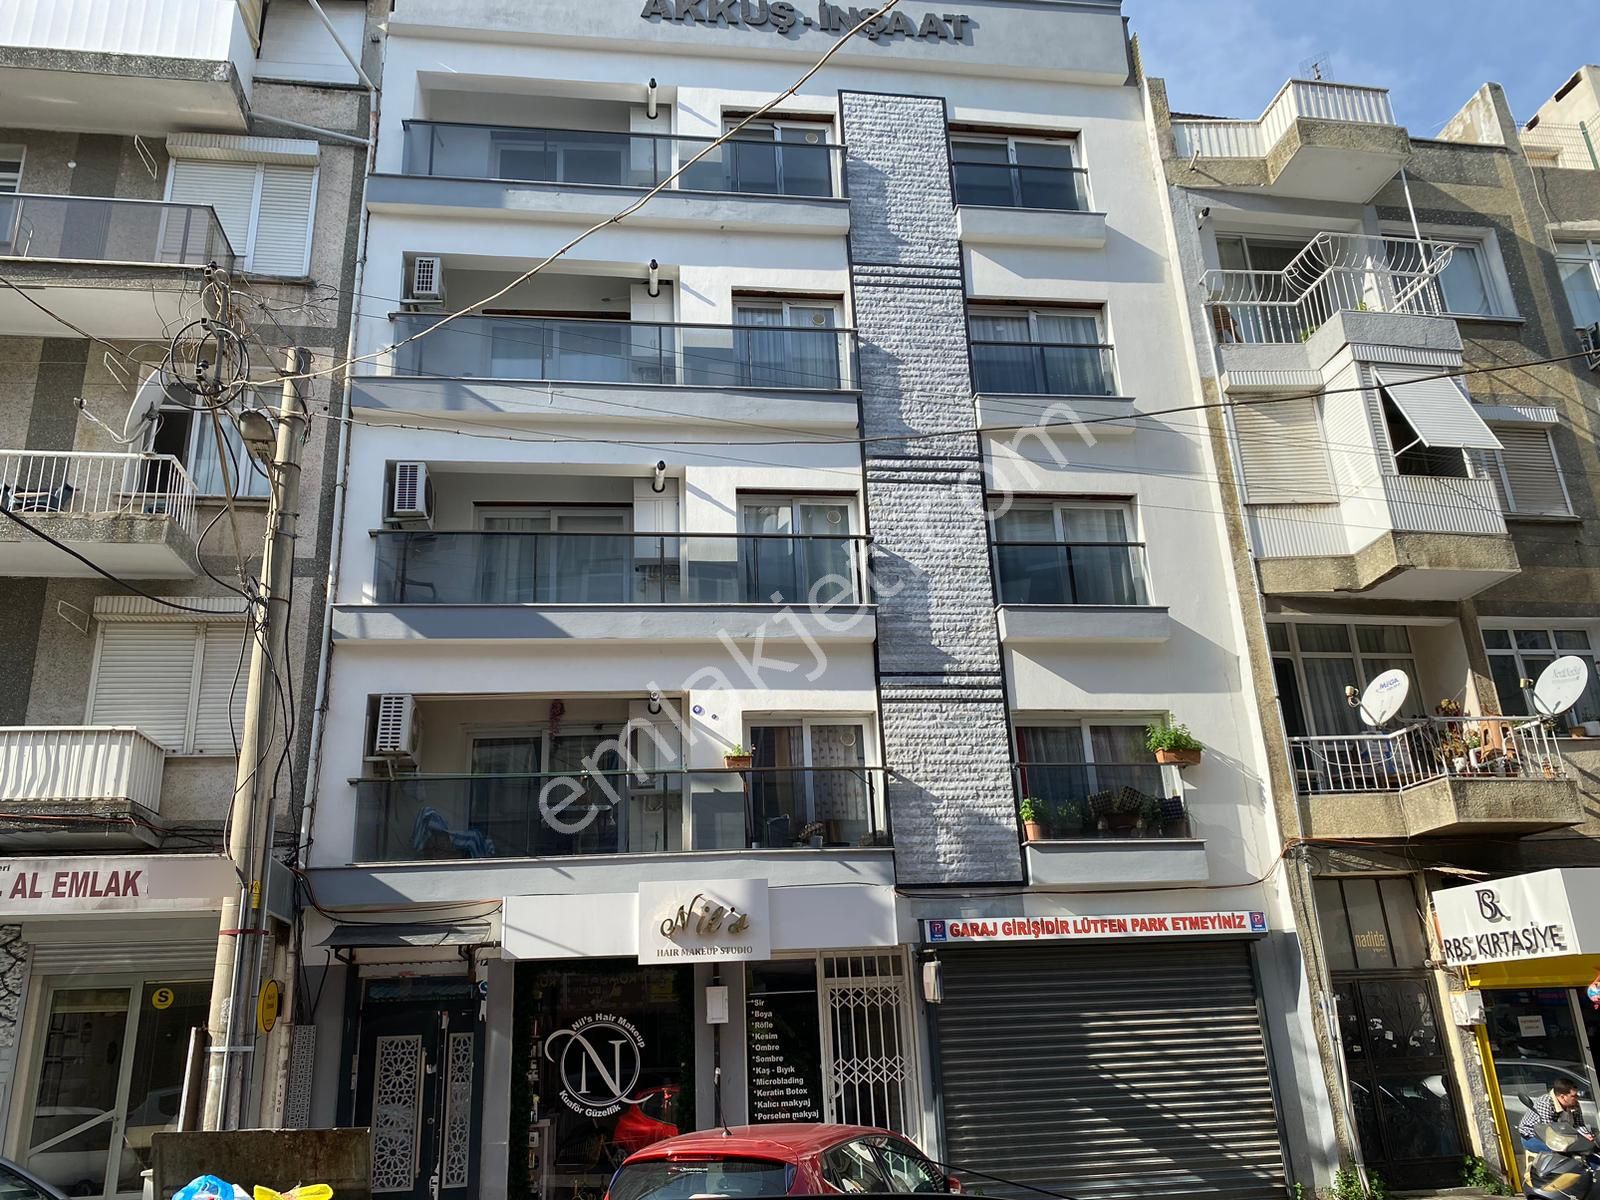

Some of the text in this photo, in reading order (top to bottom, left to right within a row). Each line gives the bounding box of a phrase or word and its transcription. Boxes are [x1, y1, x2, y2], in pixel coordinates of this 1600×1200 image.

[641, 0, 968, 40] AKKUŞ İNŞAAT
[9, 870, 142, 898] AL EMLAK
[660, 893, 750, 937] Nil's
[949, 922, 998, 938] GARAJ
[1001, 917, 1070, 938] GİRİŞİDİR
[1073, 917, 1128, 934] LÜTFEN
[1130, 916, 1169, 932] PARK
[1171, 912, 1247, 930] ETMEYİNİZ
[1355, 930, 1386, 948] nadide
[1444, 921, 1562, 960] RBS KIRTASİYE
[656, 945, 753, 957] HAIR MAKEUP STUDIO
[157, 990, 169, 1003] S
[754, 1010, 773, 1019] Boya
[571, 1012, 646, 1048] Nil's Hair Makeup
[755, 1032, 778, 1040] Kesim
[755, 1043, 780, 1051] Ombre
[755, 1054, 784, 1063] Sombre
[544, 1029, 655, 1104] N
[756, 1076, 804, 1086] Microblading
[756, 1087, 808, 1097] Keratin Botox
[559, 1089, 622, 1118] Kuaför Güzellik
[780, 1098, 811, 1107] makyaj
[757, 1109, 819, 1120] Porselen makyaj
